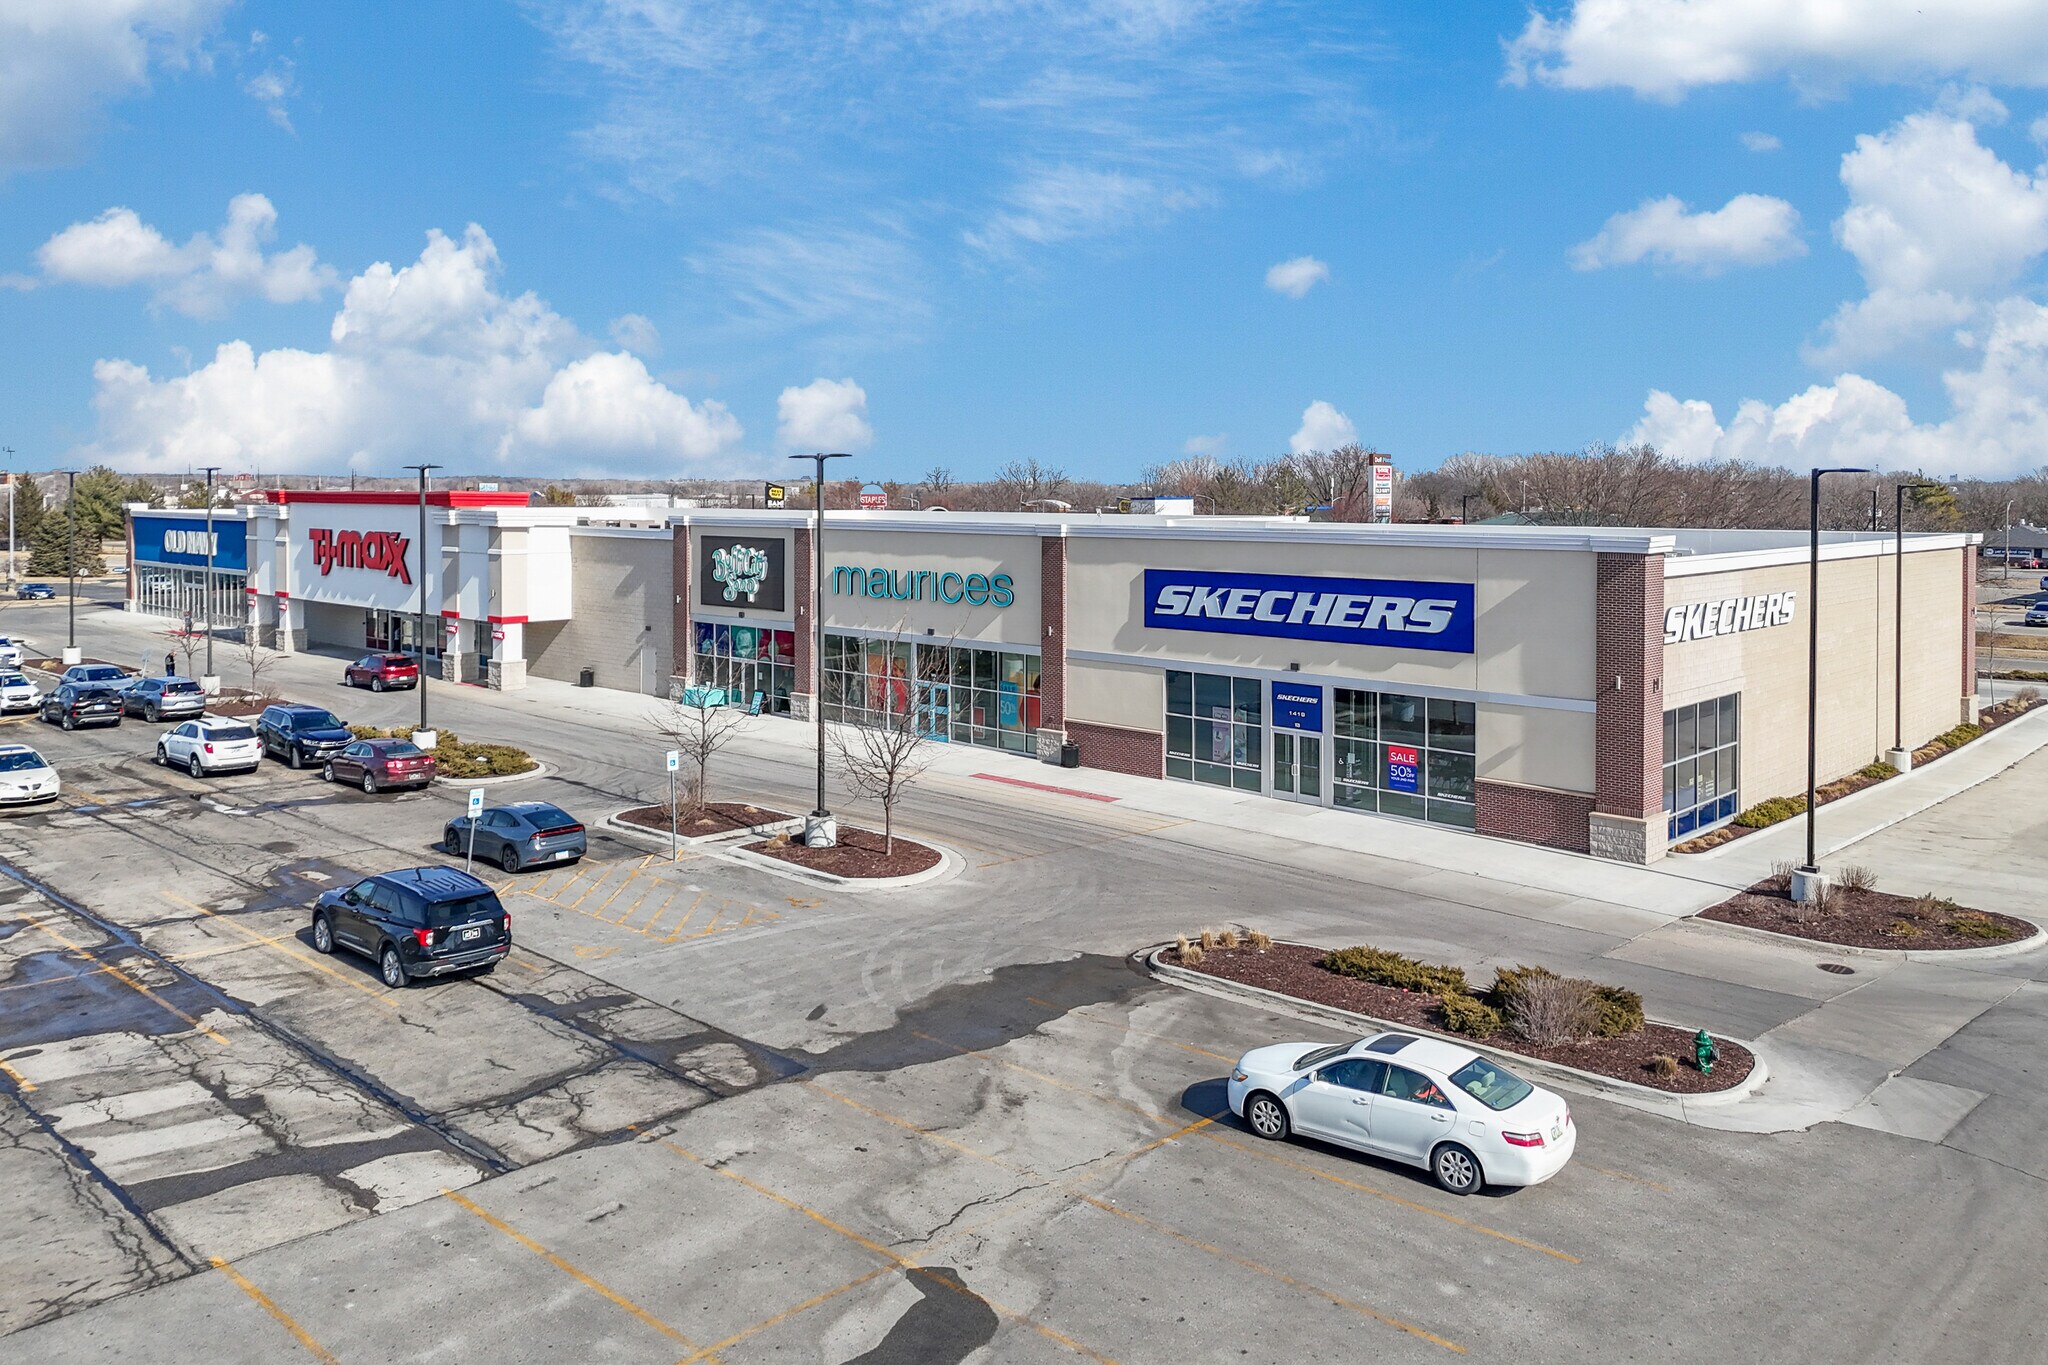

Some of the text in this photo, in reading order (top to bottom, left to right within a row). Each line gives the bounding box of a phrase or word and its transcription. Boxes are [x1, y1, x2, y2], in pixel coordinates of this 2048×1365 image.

[860, 496, 886, 504] STAPLES
[164, 529, 186, 553] OLD
[744, 547, 769, 581] City
[723, 573, 760, 603] Soap
[833, 565, 1015, 608] maurices
[1154, 584, 1458, 635] SKECHERS
[1663, 591, 1797, 645] SKECHERS
[1276, 693, 1319, 704] SKECHERS
[1390, 752, 1415, 764] SALE
[1390, 764, 1412, 778] 50%
